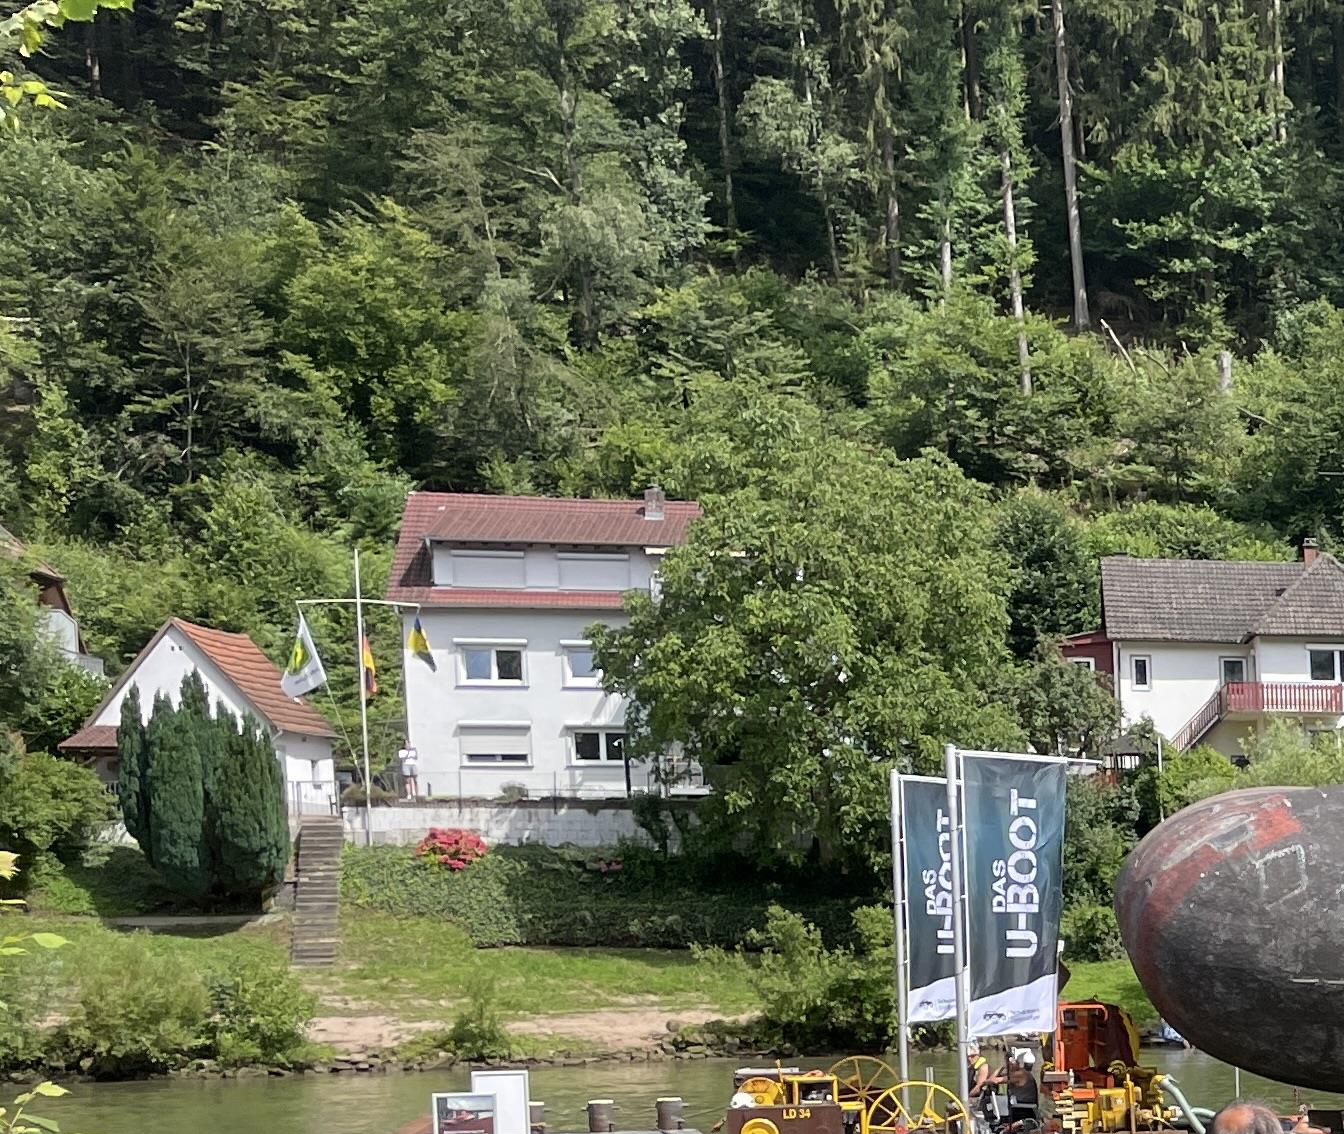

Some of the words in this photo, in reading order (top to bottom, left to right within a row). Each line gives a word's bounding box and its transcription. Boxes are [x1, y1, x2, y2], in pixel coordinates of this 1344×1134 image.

[922, 869, 937, 915] DAS
[991, 859, 1008, 913] DAS
[1005, 788, 1040, 959] U-BOOT
[783, 1108, 797, 1120] LD
